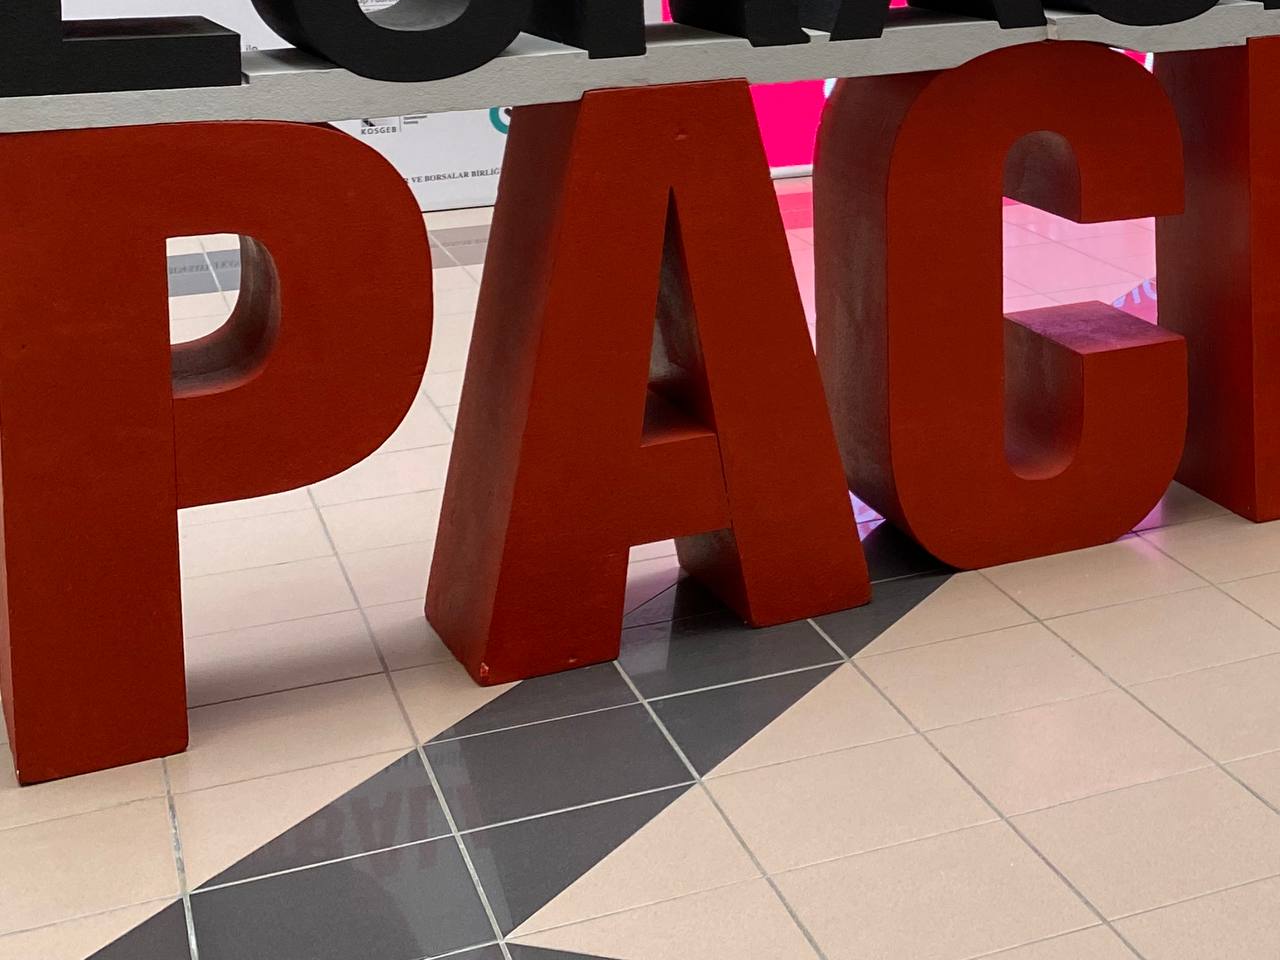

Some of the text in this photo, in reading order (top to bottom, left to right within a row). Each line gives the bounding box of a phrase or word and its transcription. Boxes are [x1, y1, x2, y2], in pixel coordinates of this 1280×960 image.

[361, 126, 397, 135] KOSGEB
[412, 175, 423, 183] VE
[424, 171, 470, 182] BORSALAR
